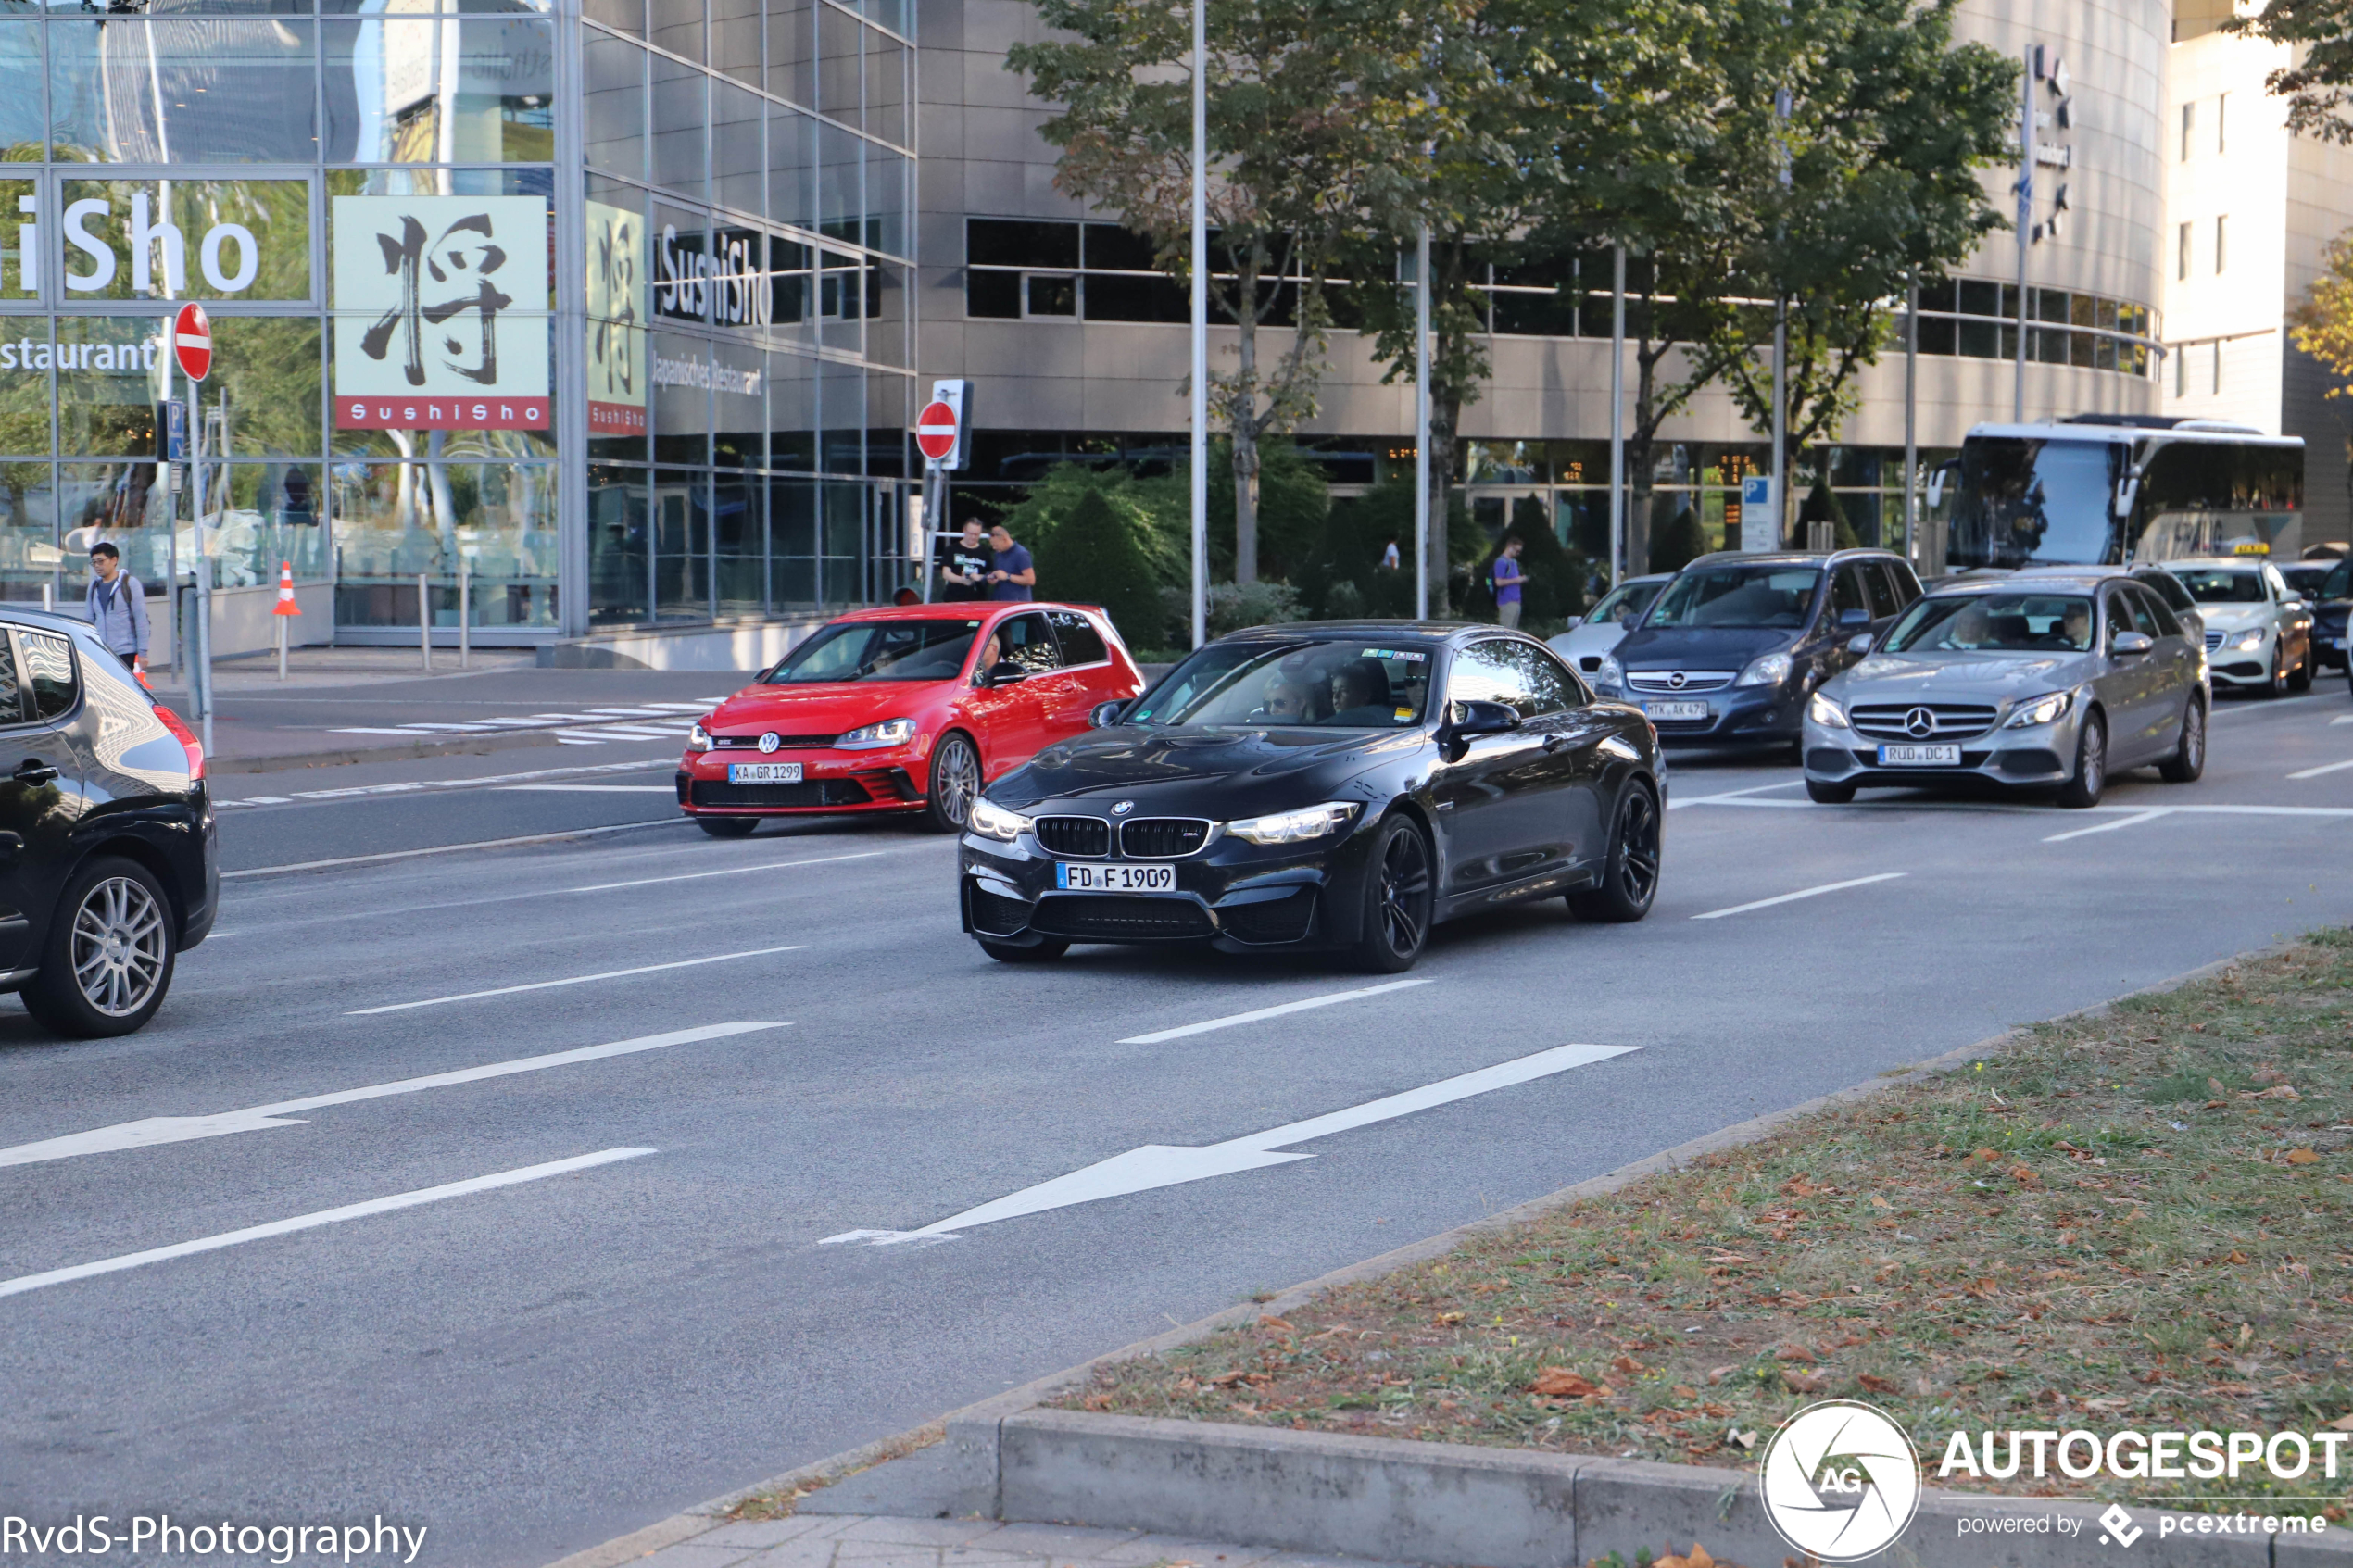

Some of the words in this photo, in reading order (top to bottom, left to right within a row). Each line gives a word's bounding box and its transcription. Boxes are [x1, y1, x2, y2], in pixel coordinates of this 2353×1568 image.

[661, 223, 774, 327] SushiSho
[652, 350, 710, 393] Japanisches
[711, 359, 762, 397] Restaurant
[350, 403, 540, 421] SushiSho
[592, 408, 646, 428] SushiSho
[1745, 481, 1758, 498] P
[1889, 747, 1915, 760] RÜD
[1925, 747, 1943, 760] DC
[1946, 747, 1954, 759] 1
[735, 766, 749, 780] KA
[757, 766, 771, 779] GR
[773, 765, 800, 779] 1299
[1067, 867, 1092, 886] FD
[1104, 869, 1116, 887] F
[1121, 869, 1171, 887] 1909
